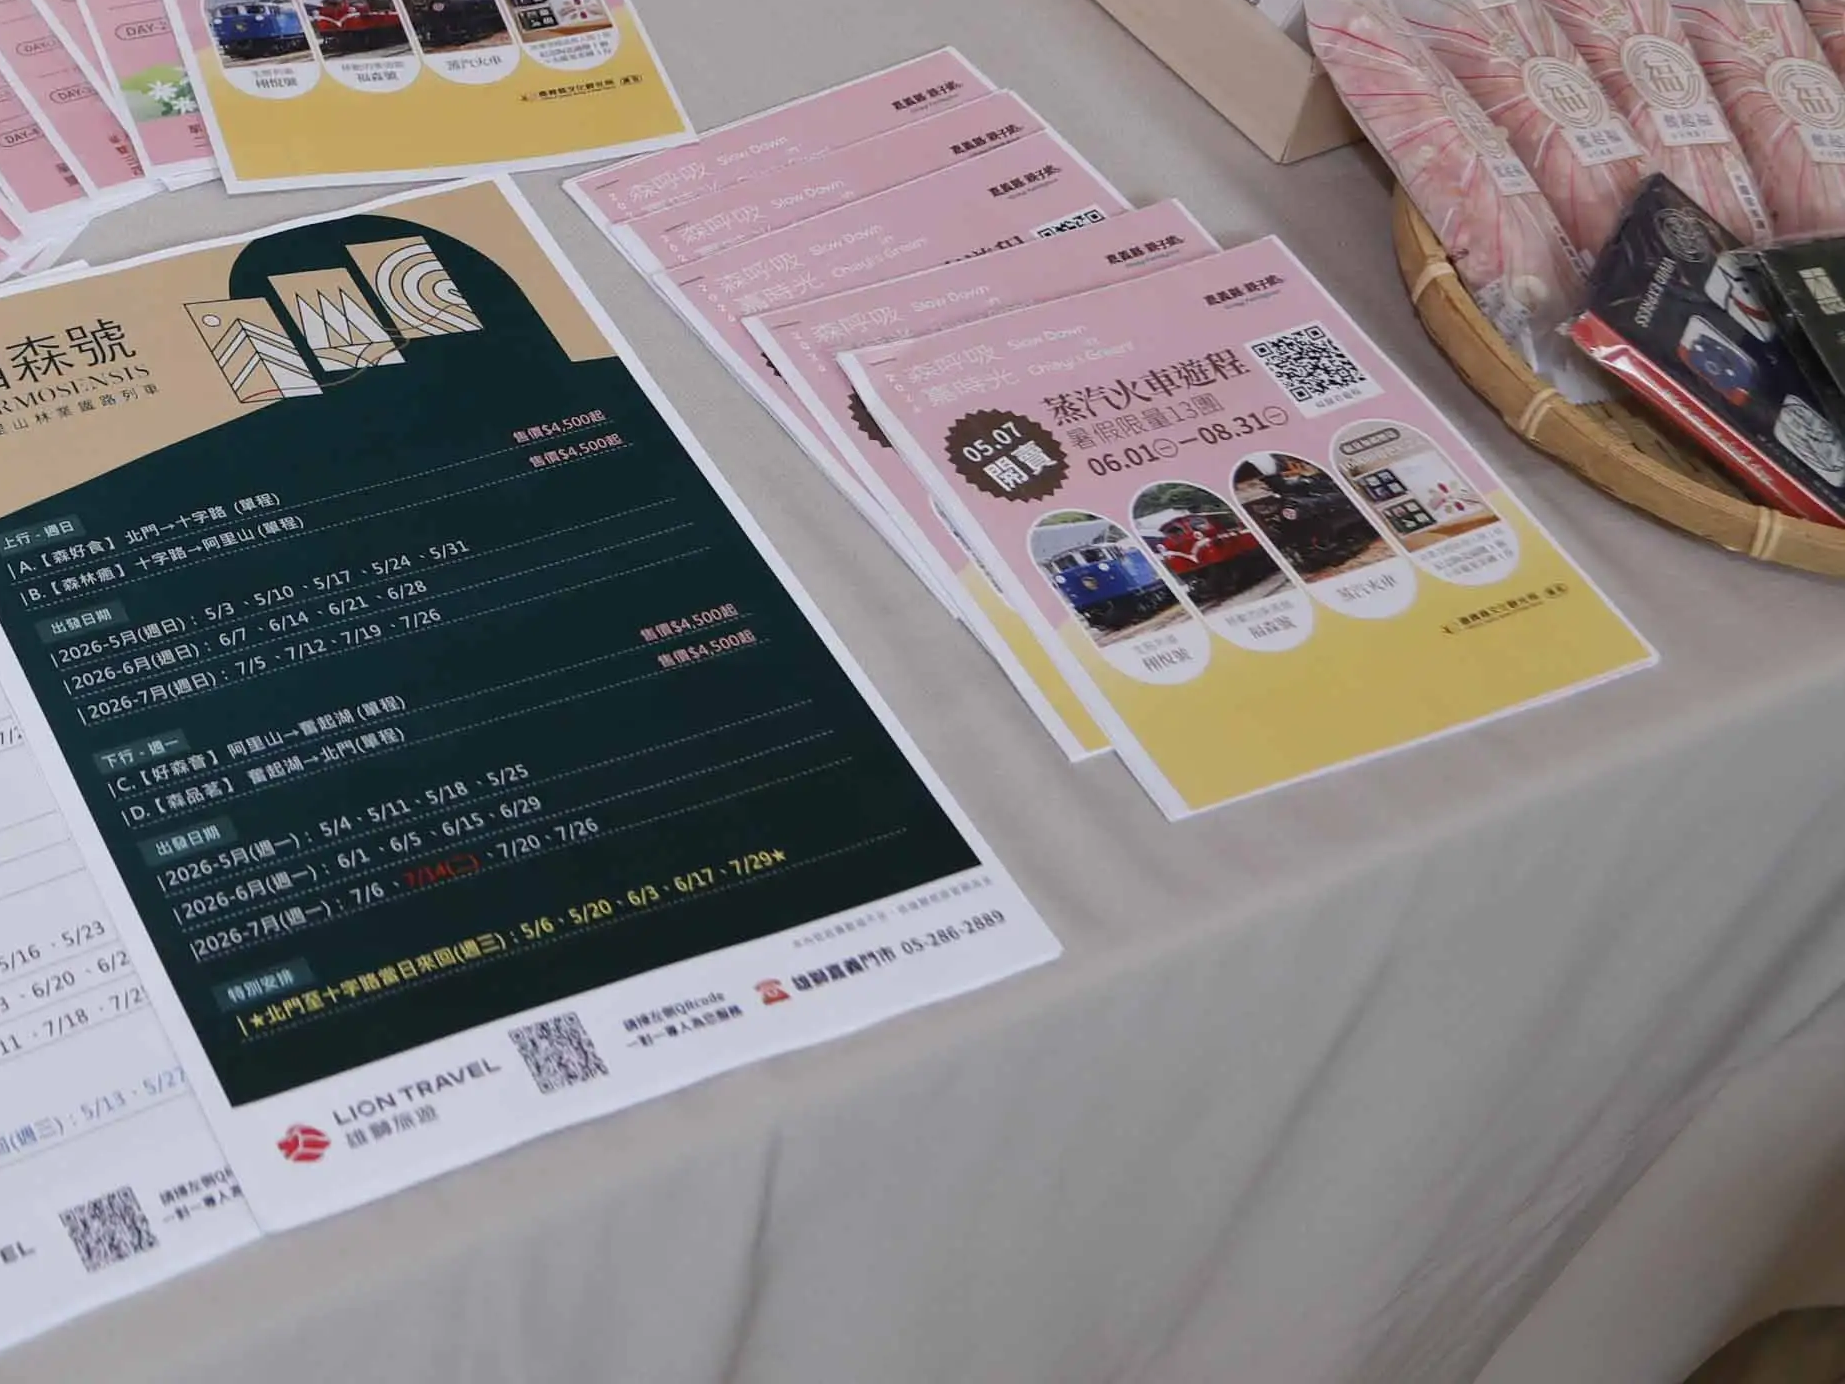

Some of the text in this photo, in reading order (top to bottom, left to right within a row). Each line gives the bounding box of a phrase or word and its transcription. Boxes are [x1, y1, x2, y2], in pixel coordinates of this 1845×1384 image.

[1038, 347, 1252, 427] 蒸汽火車遊程
[511, 409, 609, 445] 售價$4,500起
[961, 420, 1024, 464] 05.07
[1066, 391, 1227, 452] 暑假限量13團
[526, 432, 625, 469] 售價$4,500起
[982, 440, 1059, 493] 開賣
[48, 606, 115, 636] 出發日期
[637, 602, 741, 644] 售價$4,500起
[654, 627, 759, 669] 售價$4,500起
[898, 909, 1009, 956] 05-286-2889
[331, 1056, 503, 1126] LION TRAVEL
